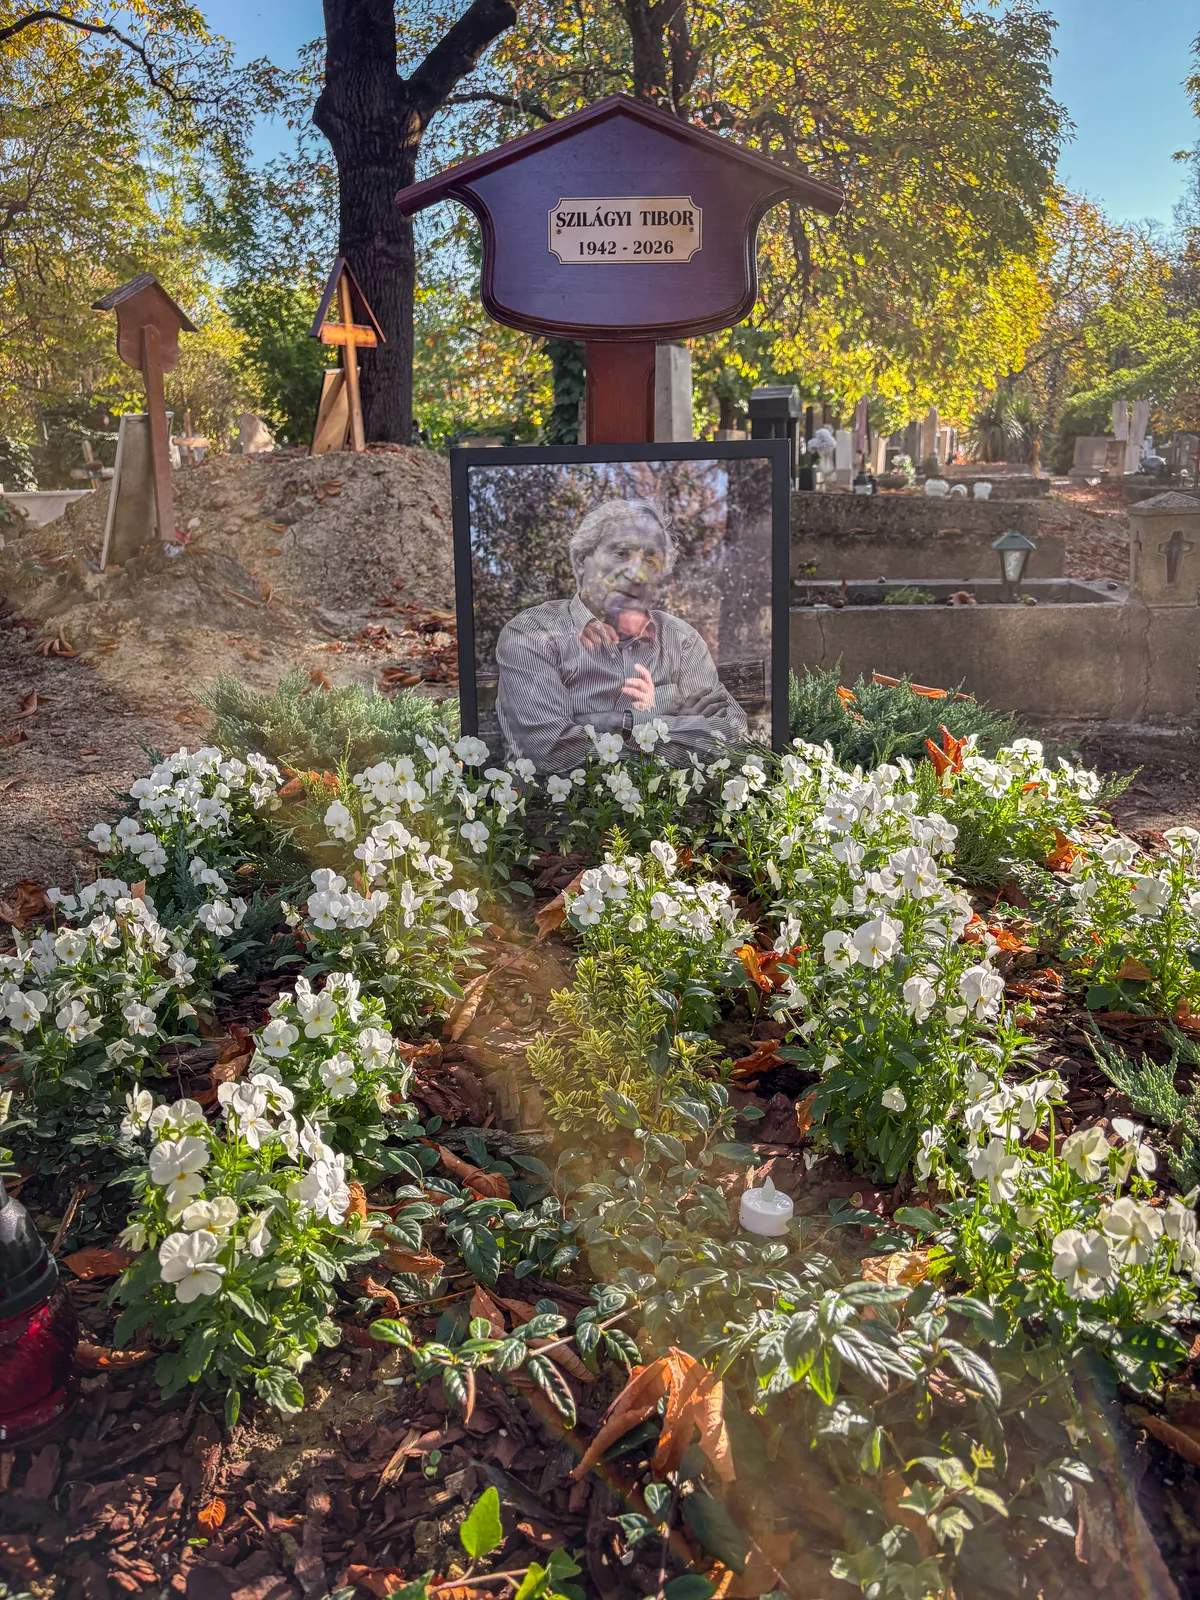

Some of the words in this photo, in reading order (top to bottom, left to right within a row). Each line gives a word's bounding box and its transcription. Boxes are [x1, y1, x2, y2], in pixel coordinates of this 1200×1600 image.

[556, 207, 632, 228] SZILÁGYI
[639, 210, 694, 226] TIBOR
[579, 241, 617, 255] 1942
[633, 240, 674, 255] 2026
